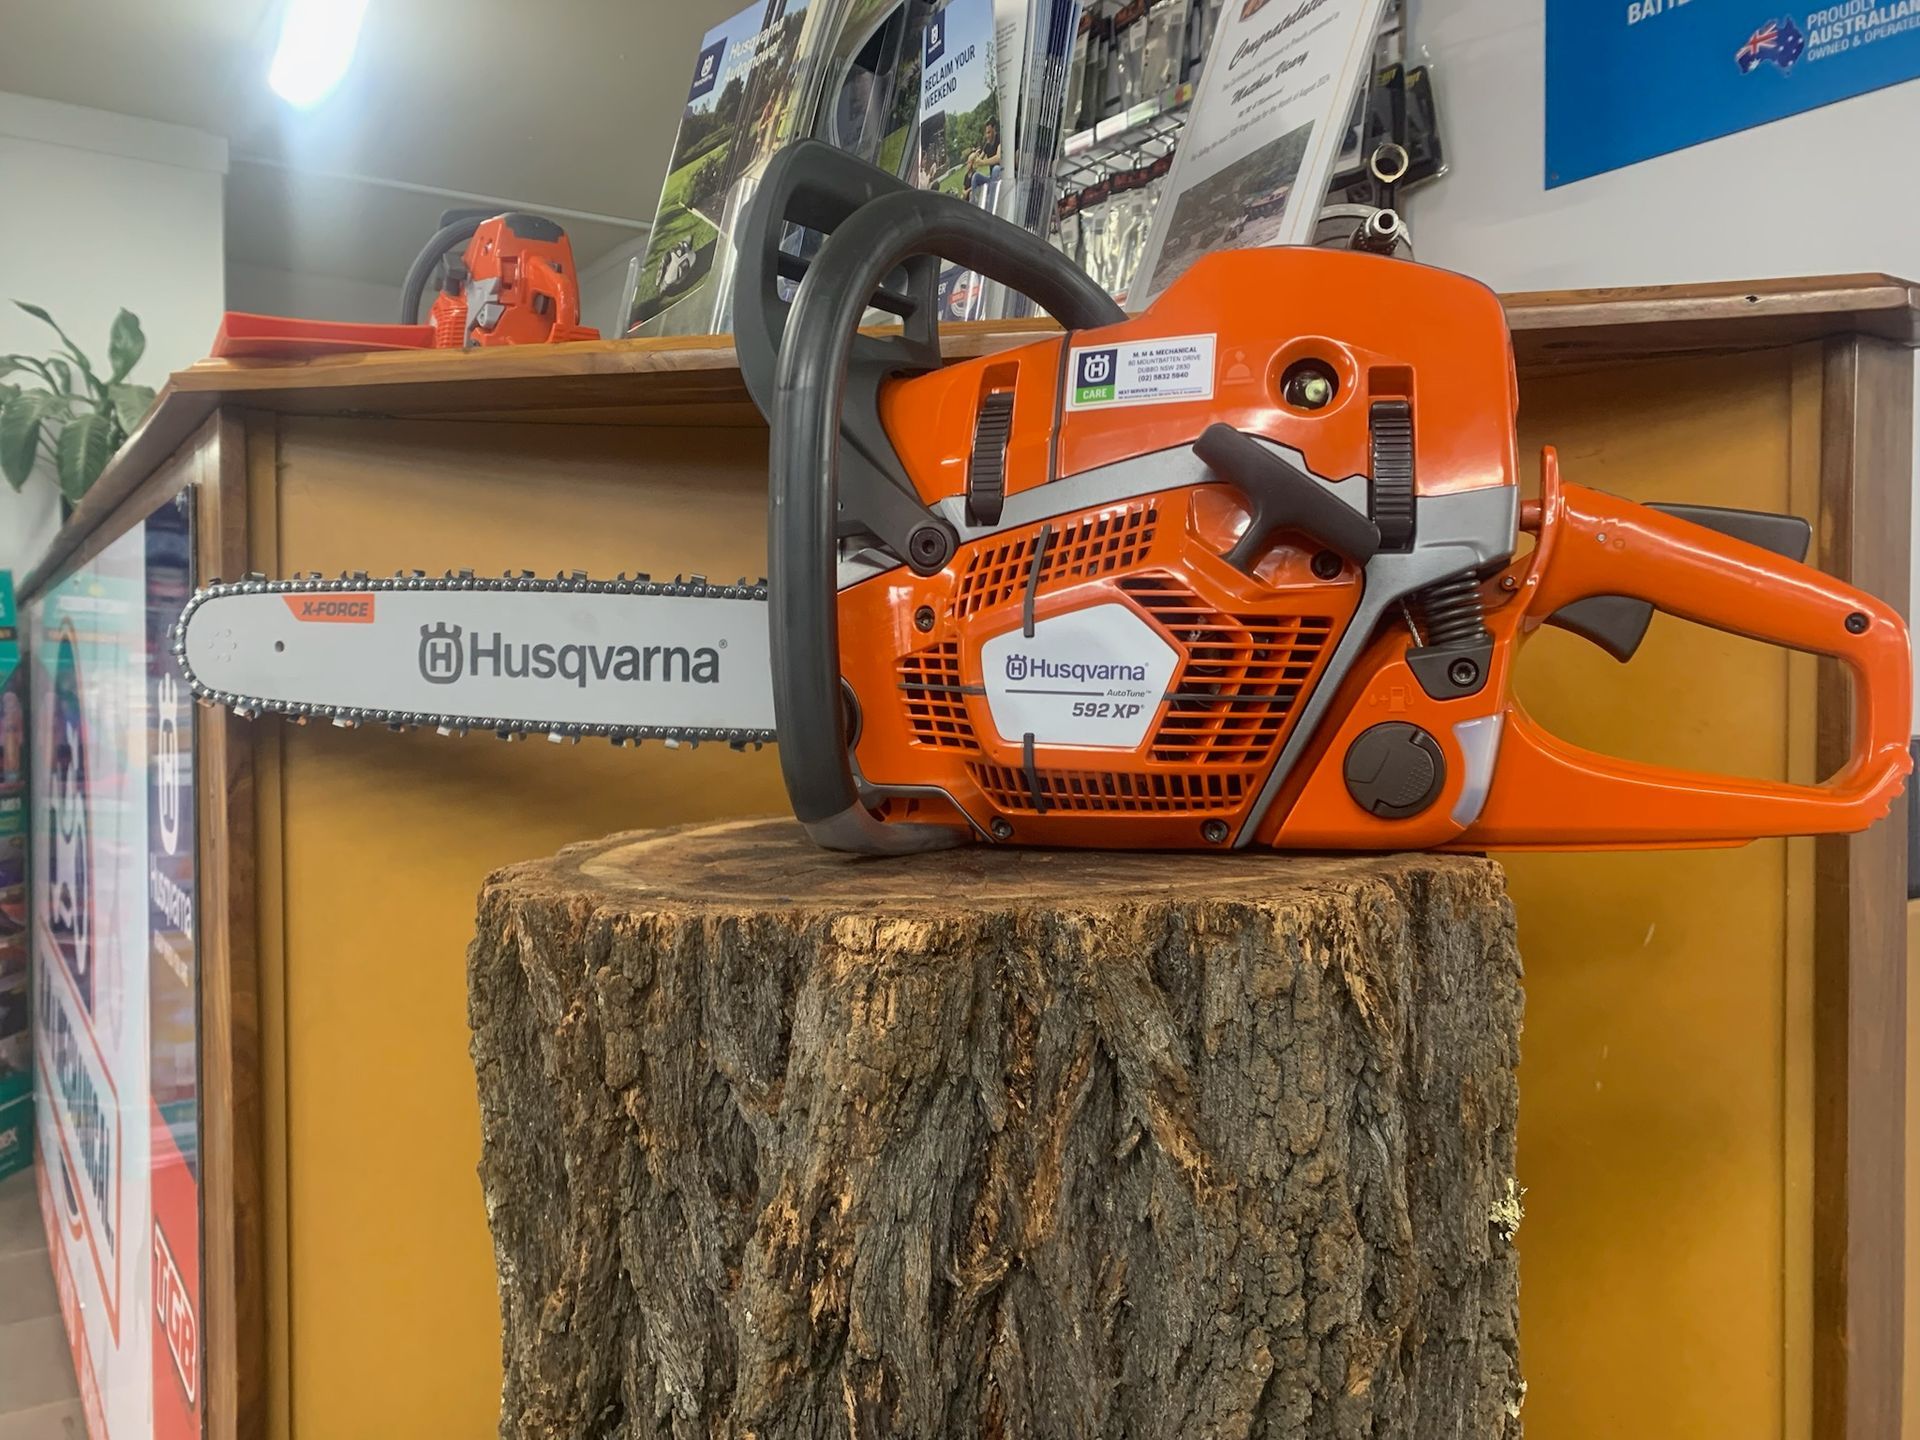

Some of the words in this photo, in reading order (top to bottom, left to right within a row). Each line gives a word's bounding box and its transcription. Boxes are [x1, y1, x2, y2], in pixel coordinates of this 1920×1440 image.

[1808, 38, 1850, 61] OWNED
[1852, 34, 1861, 47] &
[925, 60, 954, 93] RECLAIM
[955, 44, 976, 70] YOUR
[924, 77, 957, 110] WEEKEND
[1156, 347, 1197, 356] MECHANICAL
[1138, 374, 1152, 382] (02)
[1083, 388, 1107, 400] CARE
[302, 601, 369, 617] X-FORCE
[1072, 702, 1110, 718] 592
[154, 1223, 196, 1403] TGB
